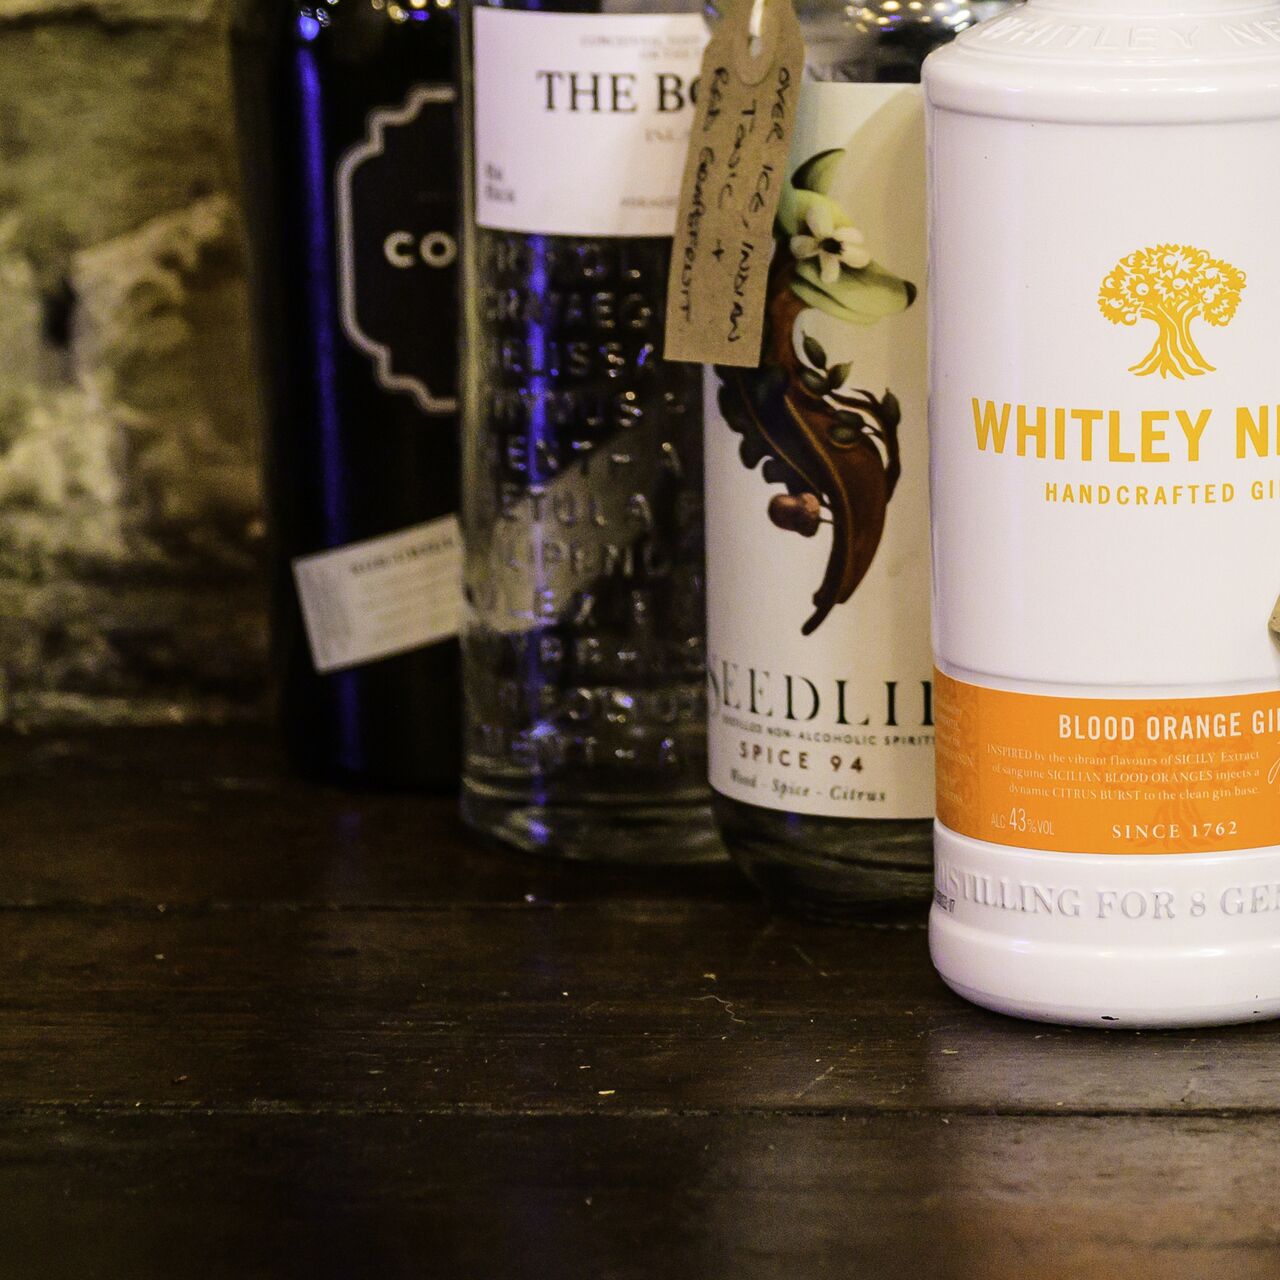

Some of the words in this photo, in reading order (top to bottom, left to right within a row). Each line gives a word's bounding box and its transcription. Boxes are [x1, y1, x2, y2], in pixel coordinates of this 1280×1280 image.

[536, 70, 638, 113] THE
[384, 231, 457, 269] CO
[971, 397, 1213, 463] WHITLEY
[1045, 481, 1235, 505] HANDCRAFTED
[707, 659, 935, 726] EEDLI
[884, 734, 935, 747] SPIRIT
[1058, 714, 1136, 741] BLOOD
[1146, 711, 1242, 741] ORANGE
[739, 740, 808, 770] SPICE
[830, 754, 864, 774] 94
[987, 743, 1033, 760] INSPIRED
[1049, 751, 1066, 764] the
[1068, 752, 1107, 765] vibrant
[1110, 754, 1158, 767] flavours
[1160, 754, 1174, 766] of
[1174, 751, 1217, 764] SICILY
[1221, 750, 1261, 763] Extract
[1001, 764, 1046, 780] sanguine
[1047, 768, 1102, 783] SICILIAN
[1105, 771, 1149, 784] BLOOD
[1151, 769, 1214, 784] ORANGES
[1216, 768, 1252, 782] injects
[1008, 782, 1051, 798] dynamic
[1052, 786, 1098, 800] CITRUS
[1100, 789, 1143, 801] BURST
[1143, 790, 1157, 801] to
[1157, 789, 1178, 801] the
[1179, 788, 1211, 801] clean
[1212, 787, 1233, 802] gin
[1112, 823, 1181, 840] SINCE
[1190, 820, 1239, 839] 1762
[1096, 888, 1176, 921] FOR
[1189, 888, 1208, 918] 8
